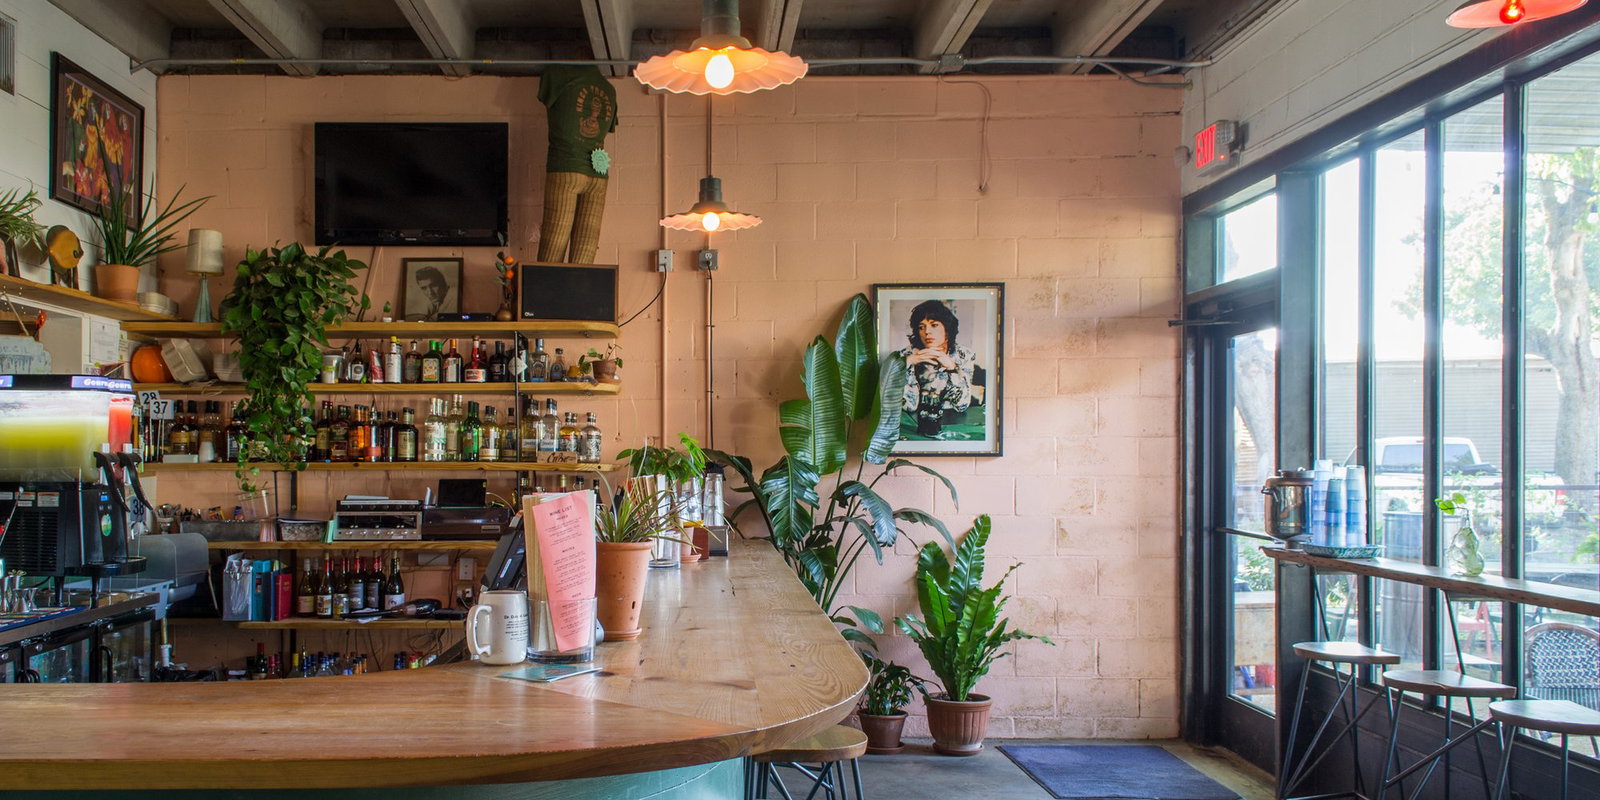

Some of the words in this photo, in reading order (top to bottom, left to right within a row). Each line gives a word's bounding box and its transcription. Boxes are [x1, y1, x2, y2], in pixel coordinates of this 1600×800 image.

[1196, 124, 1216, 168] EXIT
[153, 401, 168, 414] 37
[133, 499, 145, 515] 38
